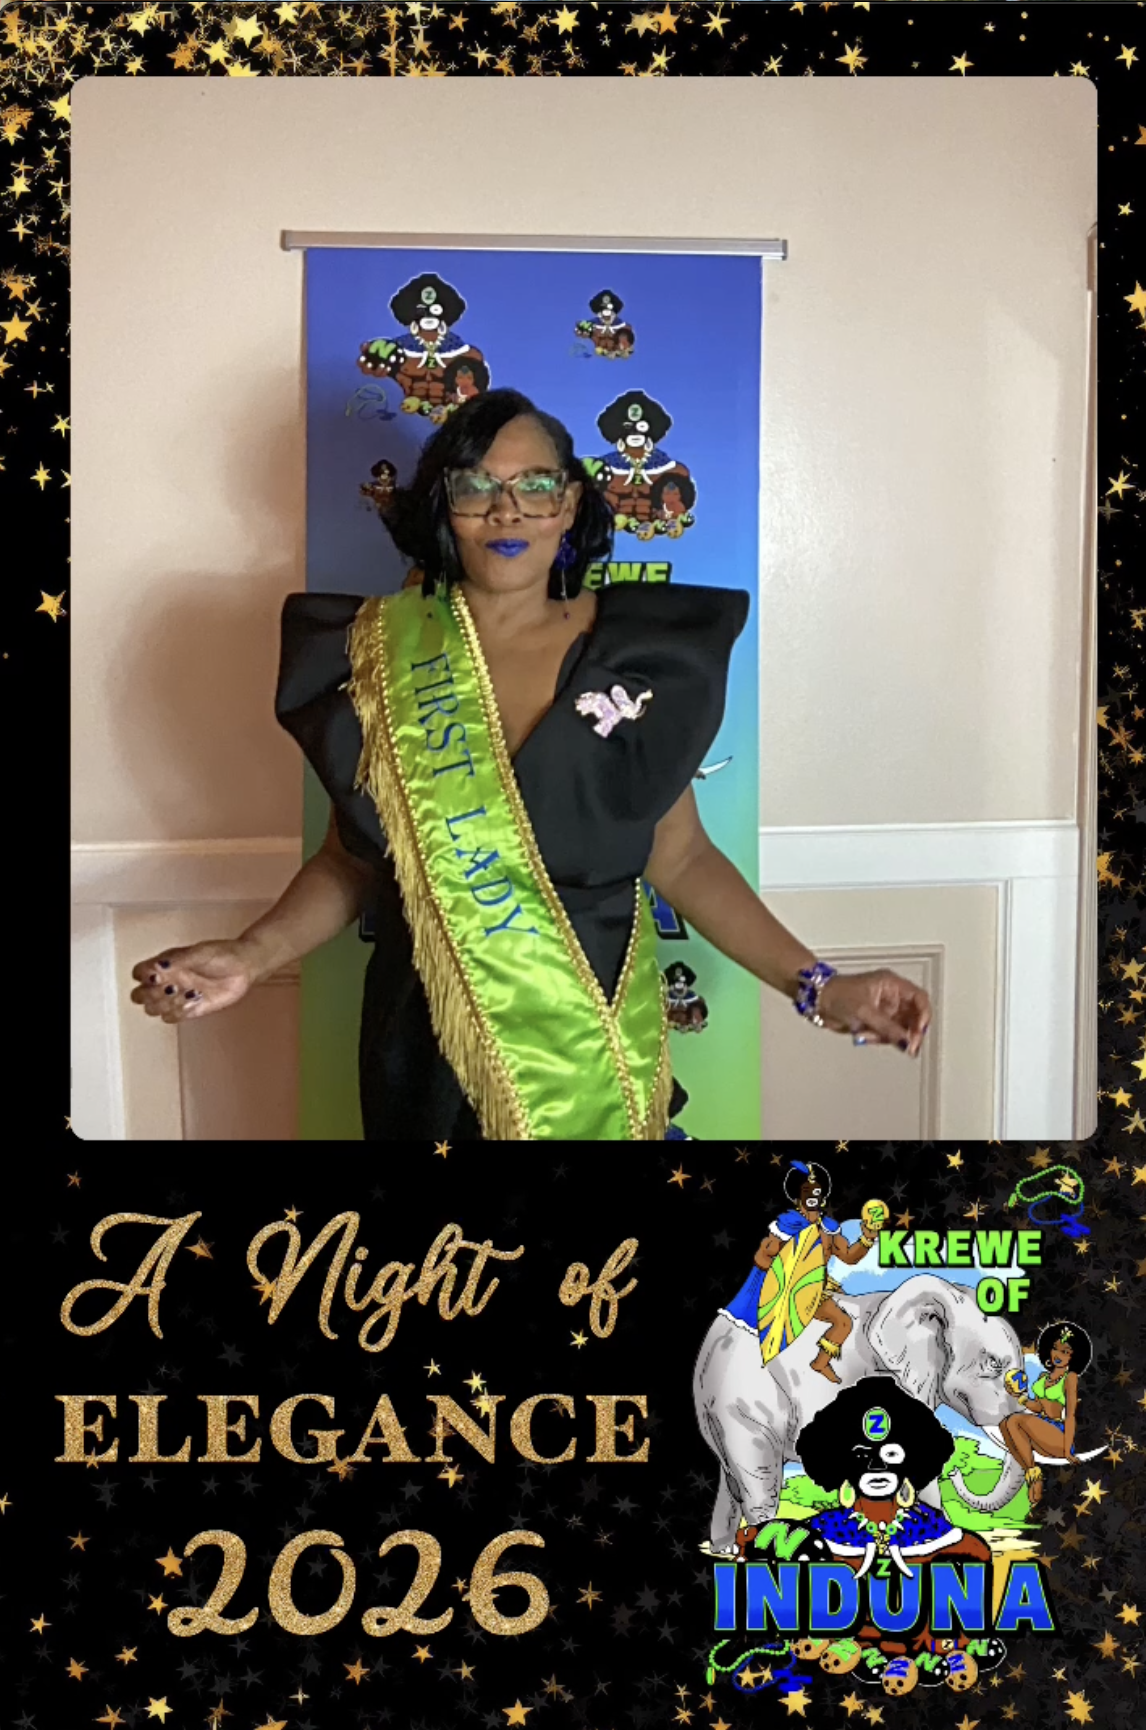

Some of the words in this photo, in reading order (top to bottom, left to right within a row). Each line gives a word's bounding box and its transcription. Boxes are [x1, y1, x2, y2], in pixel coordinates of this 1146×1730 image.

[582, 562, 669, 590] EWE
[411, 652, 475, 778] FIRST
[445, 804, 541, 938] LADY
